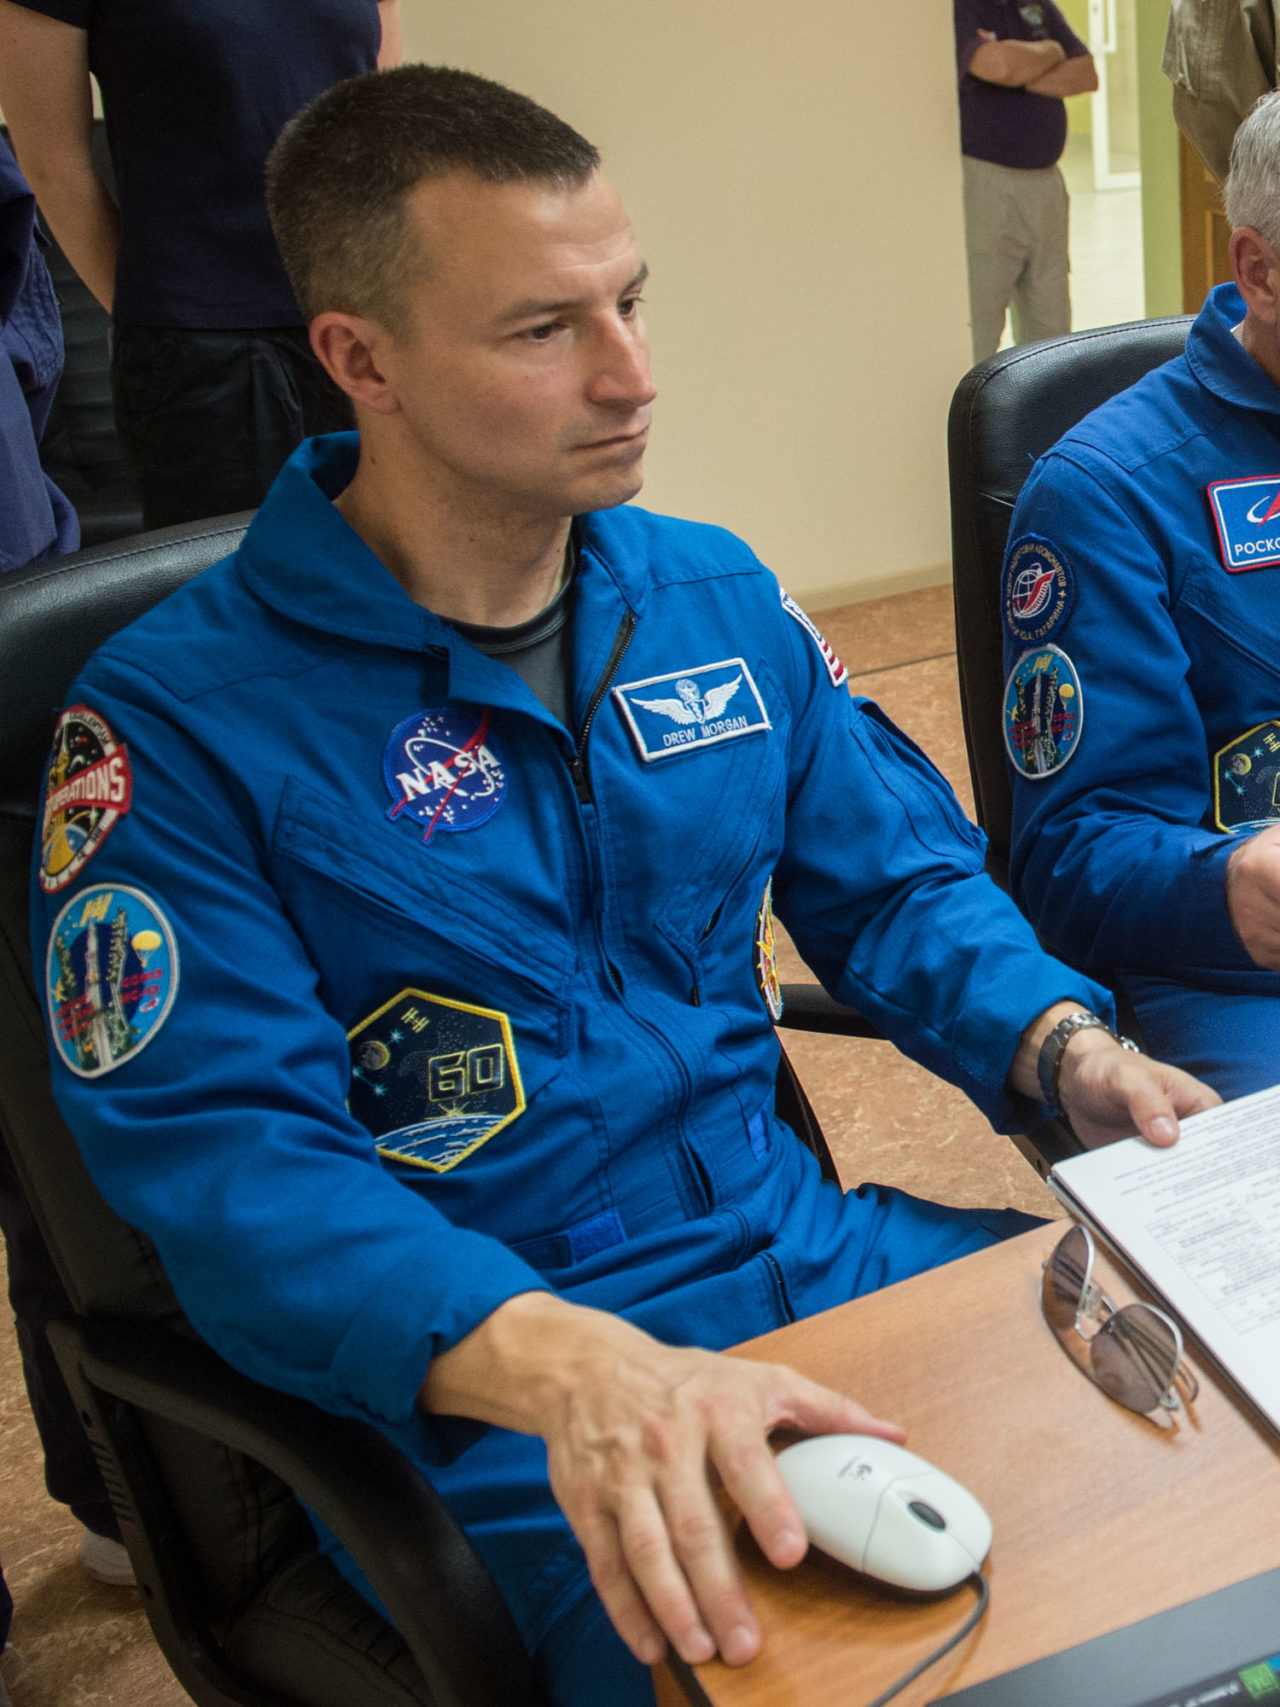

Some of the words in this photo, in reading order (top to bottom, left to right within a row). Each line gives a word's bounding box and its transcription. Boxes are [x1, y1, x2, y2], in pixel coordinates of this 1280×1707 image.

[662, 727, 697, 747] DREW
[700, 715, 749, 738] MORGAN
[395, 745, 501, 802] NASA
[428, 1042, 505, 1102] 60
